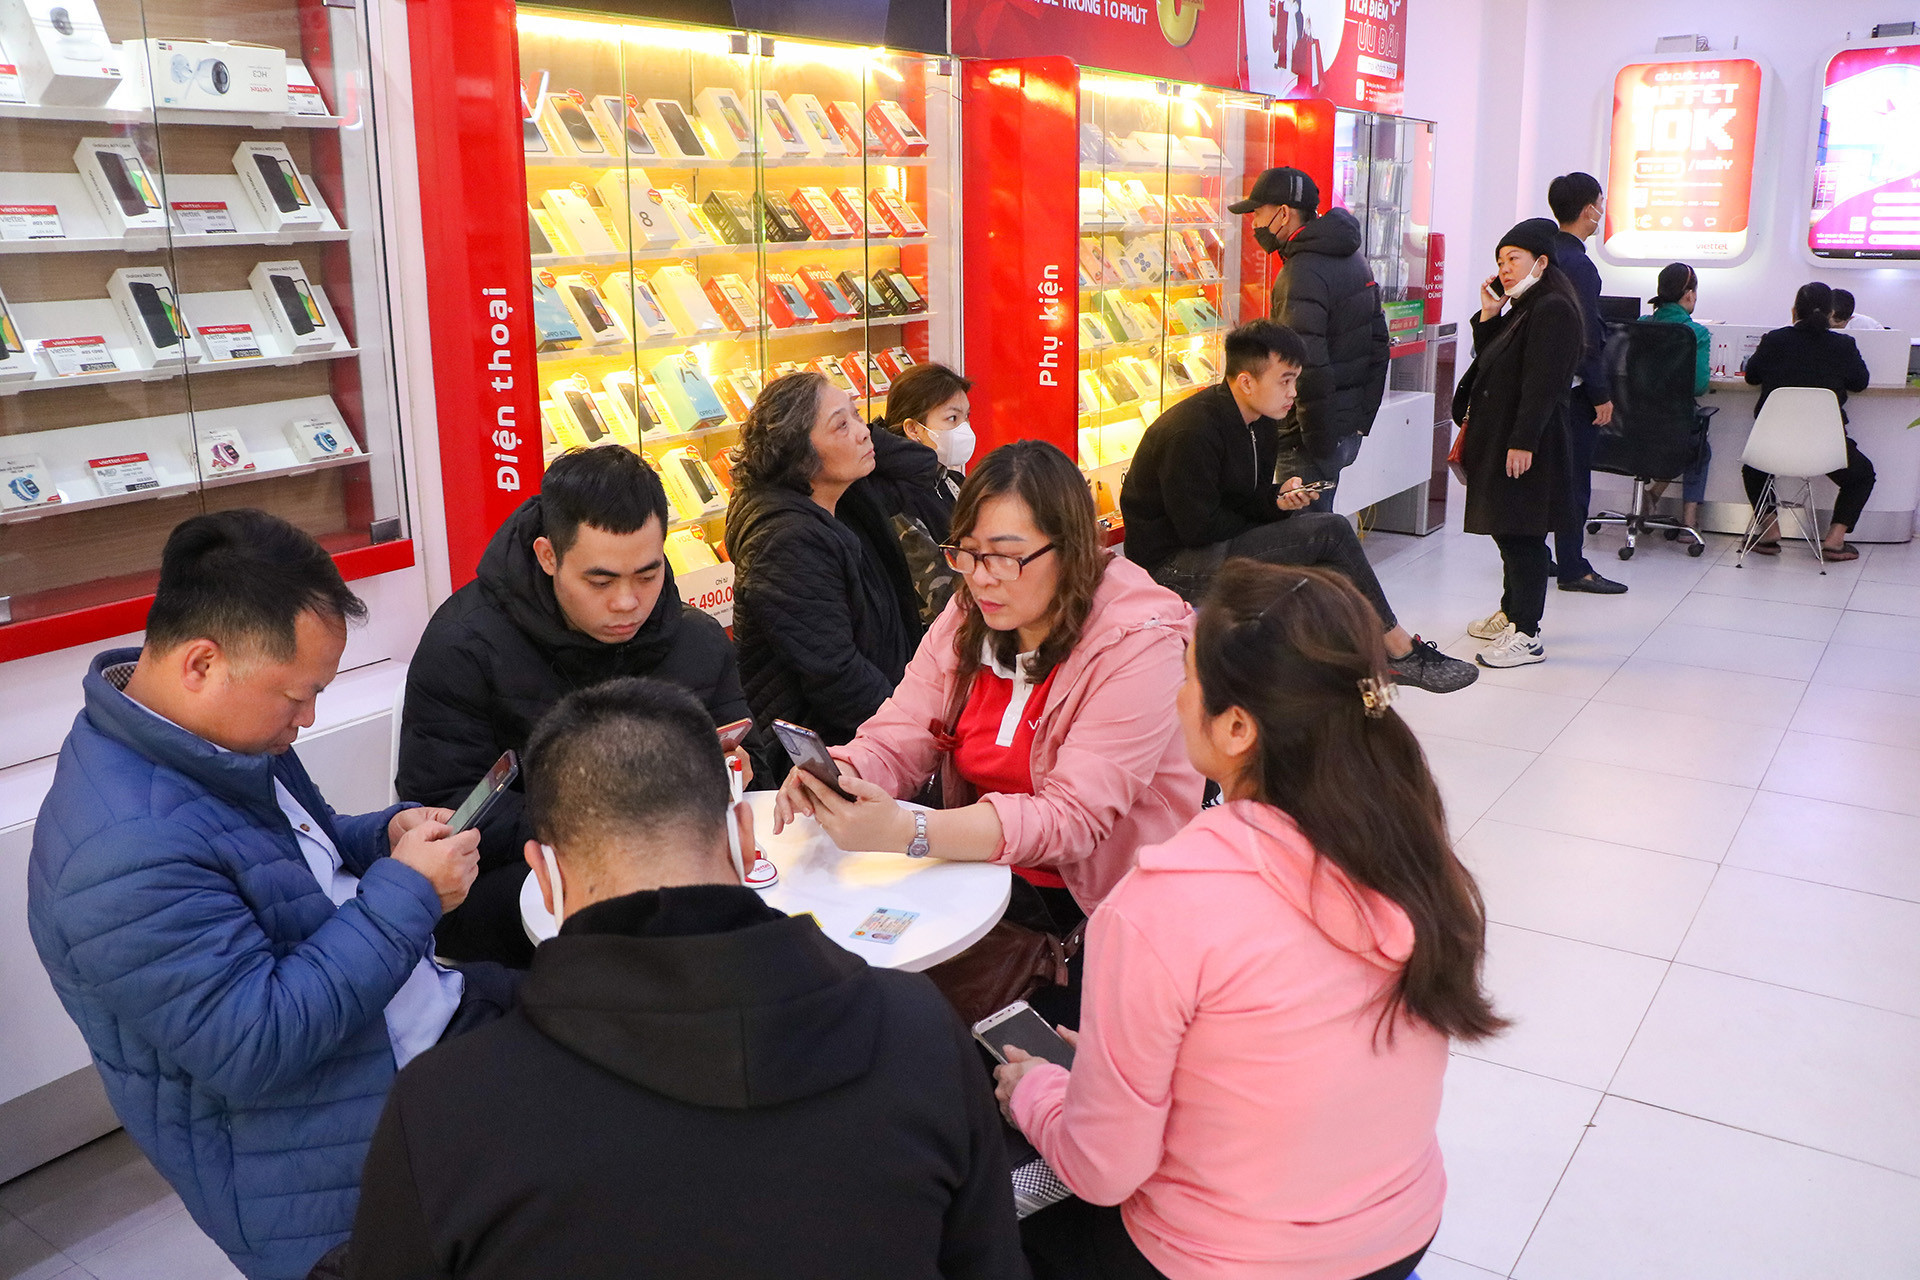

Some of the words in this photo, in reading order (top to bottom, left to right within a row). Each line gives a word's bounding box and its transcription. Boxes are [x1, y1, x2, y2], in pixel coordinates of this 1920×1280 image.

[1104, 1, 1119, 19] 10
[1119, 4, 1148, 25] PHÚT
[1358, 19, 1377, 53] ƯU
[1634, 83, 1739, 105] UFFET
[639, 211, 654, 228] 8
[1037, 264, 1063, 320] kiện
[482, 288, 514, 392] thoại
[1038, 336, 1063, 386] Phụ
[491, 406, 523, 492] Điện
